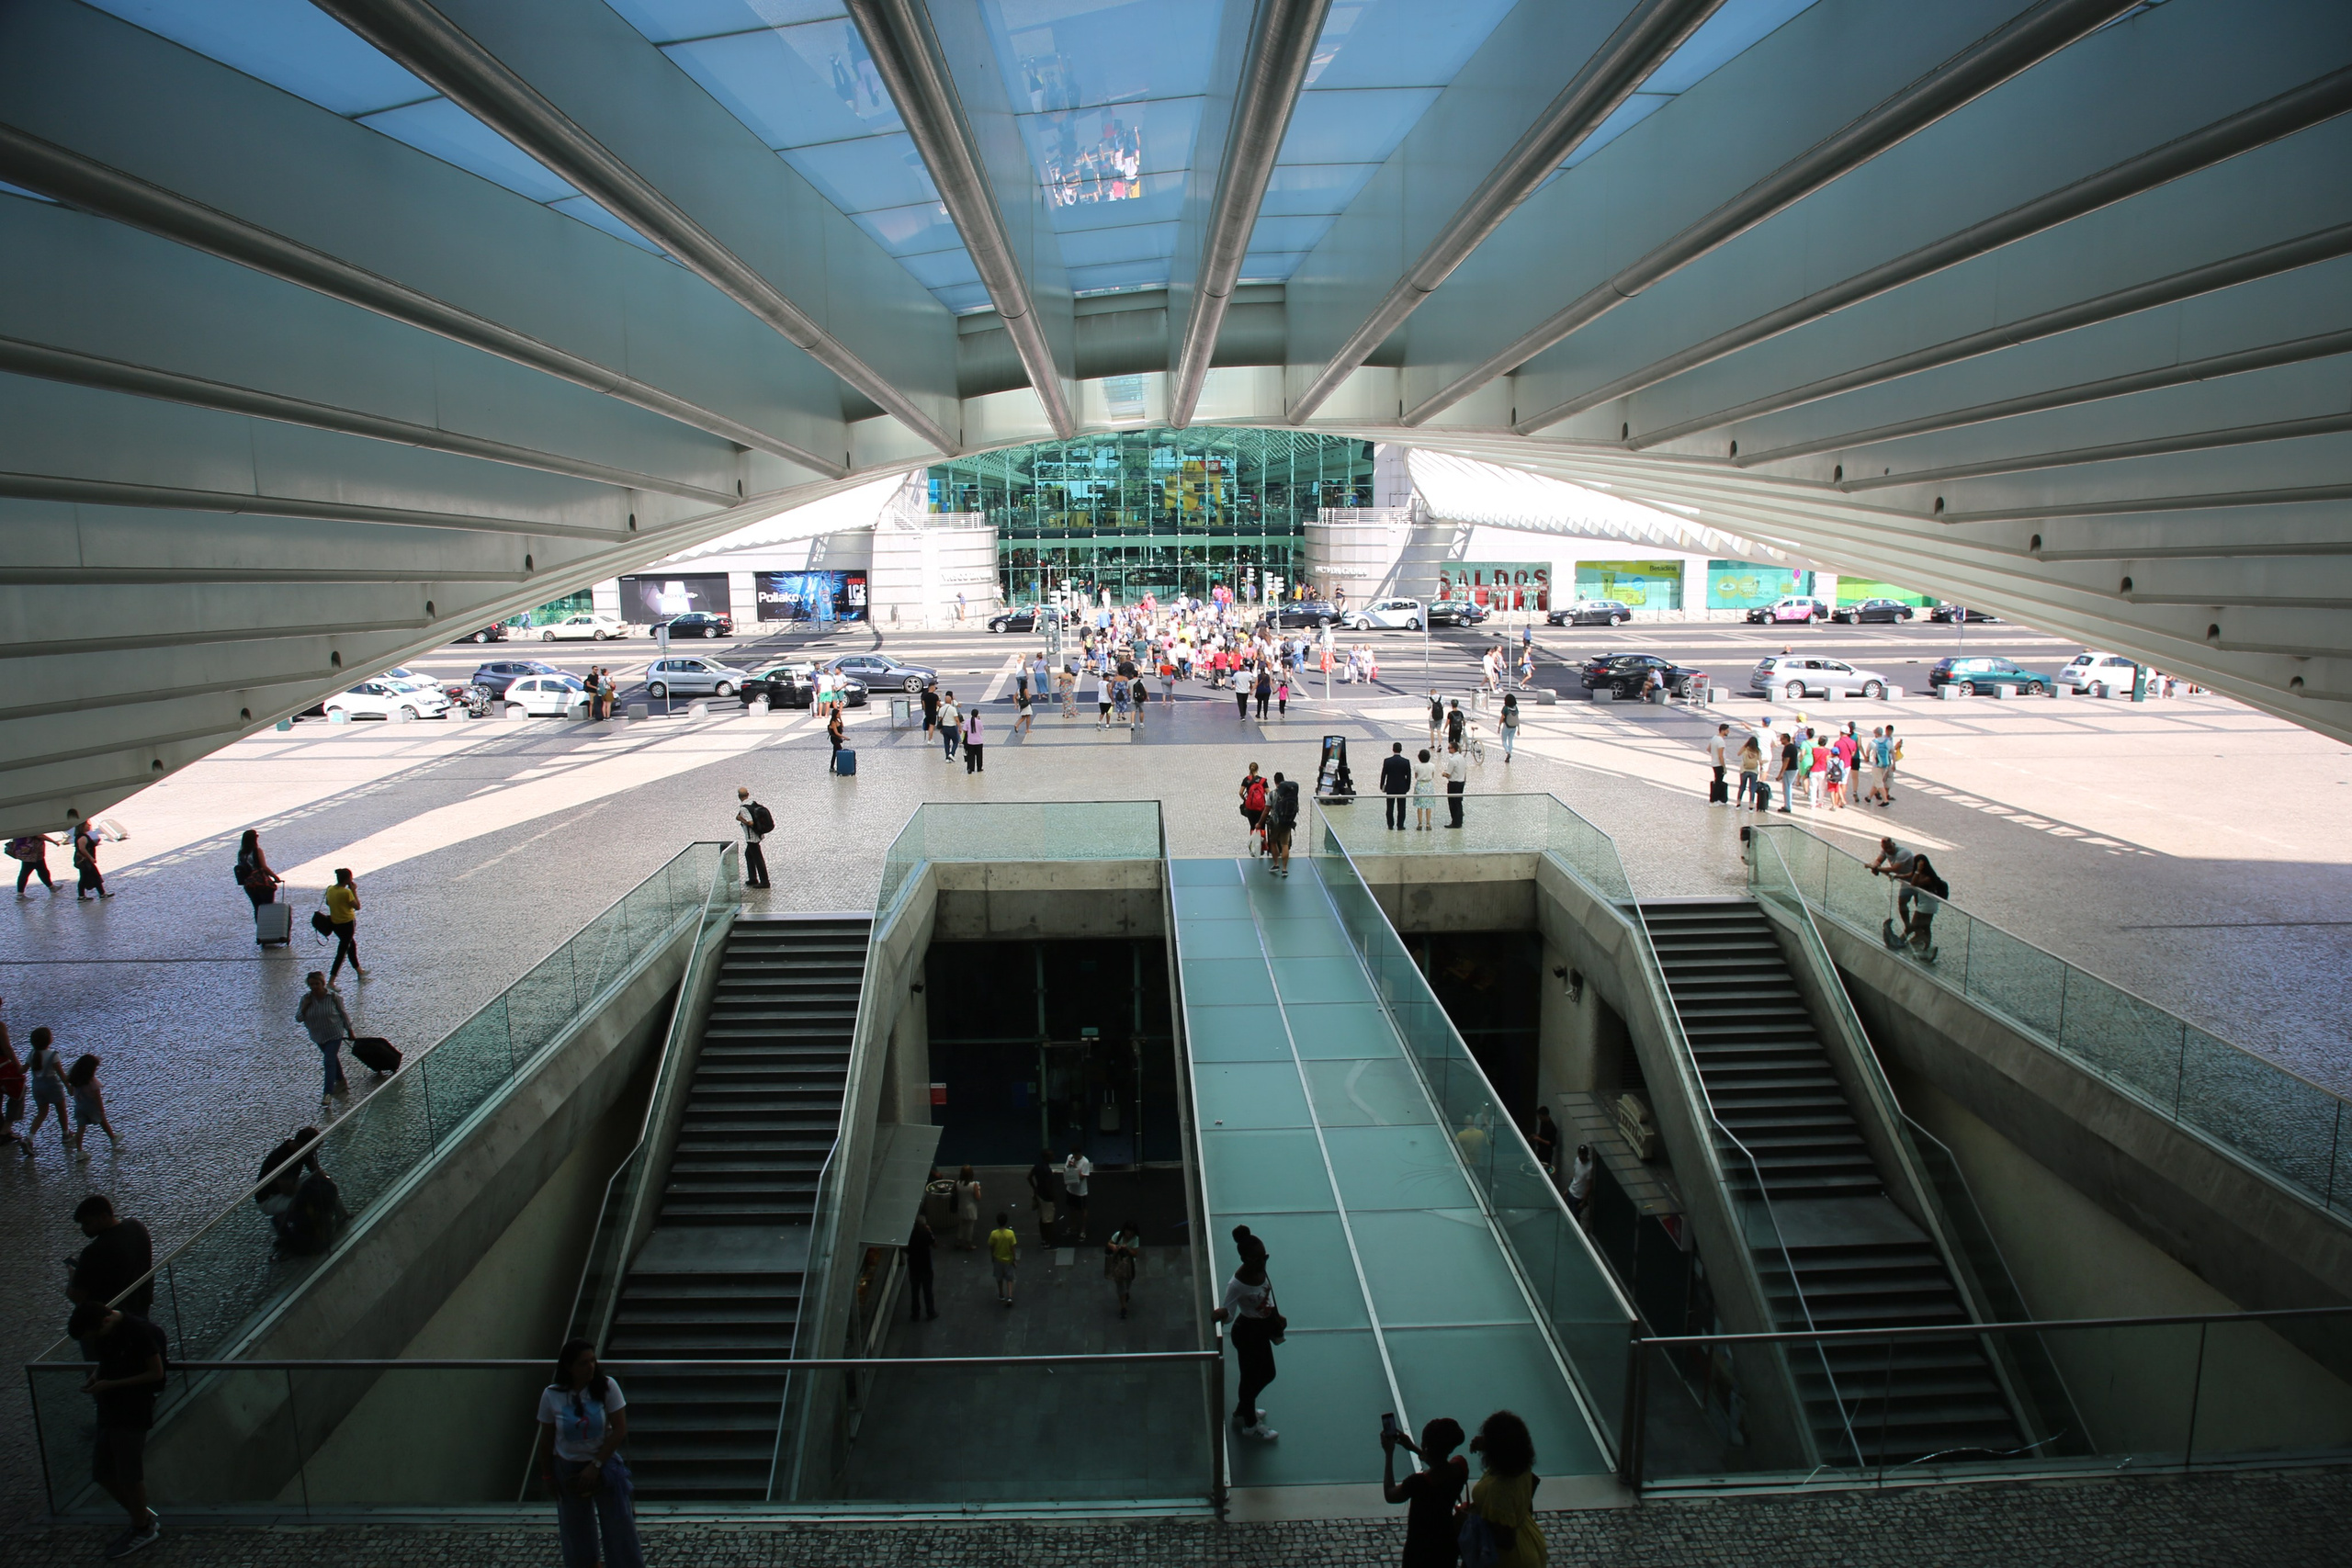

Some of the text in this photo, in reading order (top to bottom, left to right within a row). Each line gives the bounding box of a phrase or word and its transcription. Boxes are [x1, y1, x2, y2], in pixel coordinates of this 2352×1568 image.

[1441, 570, 1548, 586] SALDOS
[758, 591, 805, 604] Poliakov
[848, 584, 866, 600] ICE
